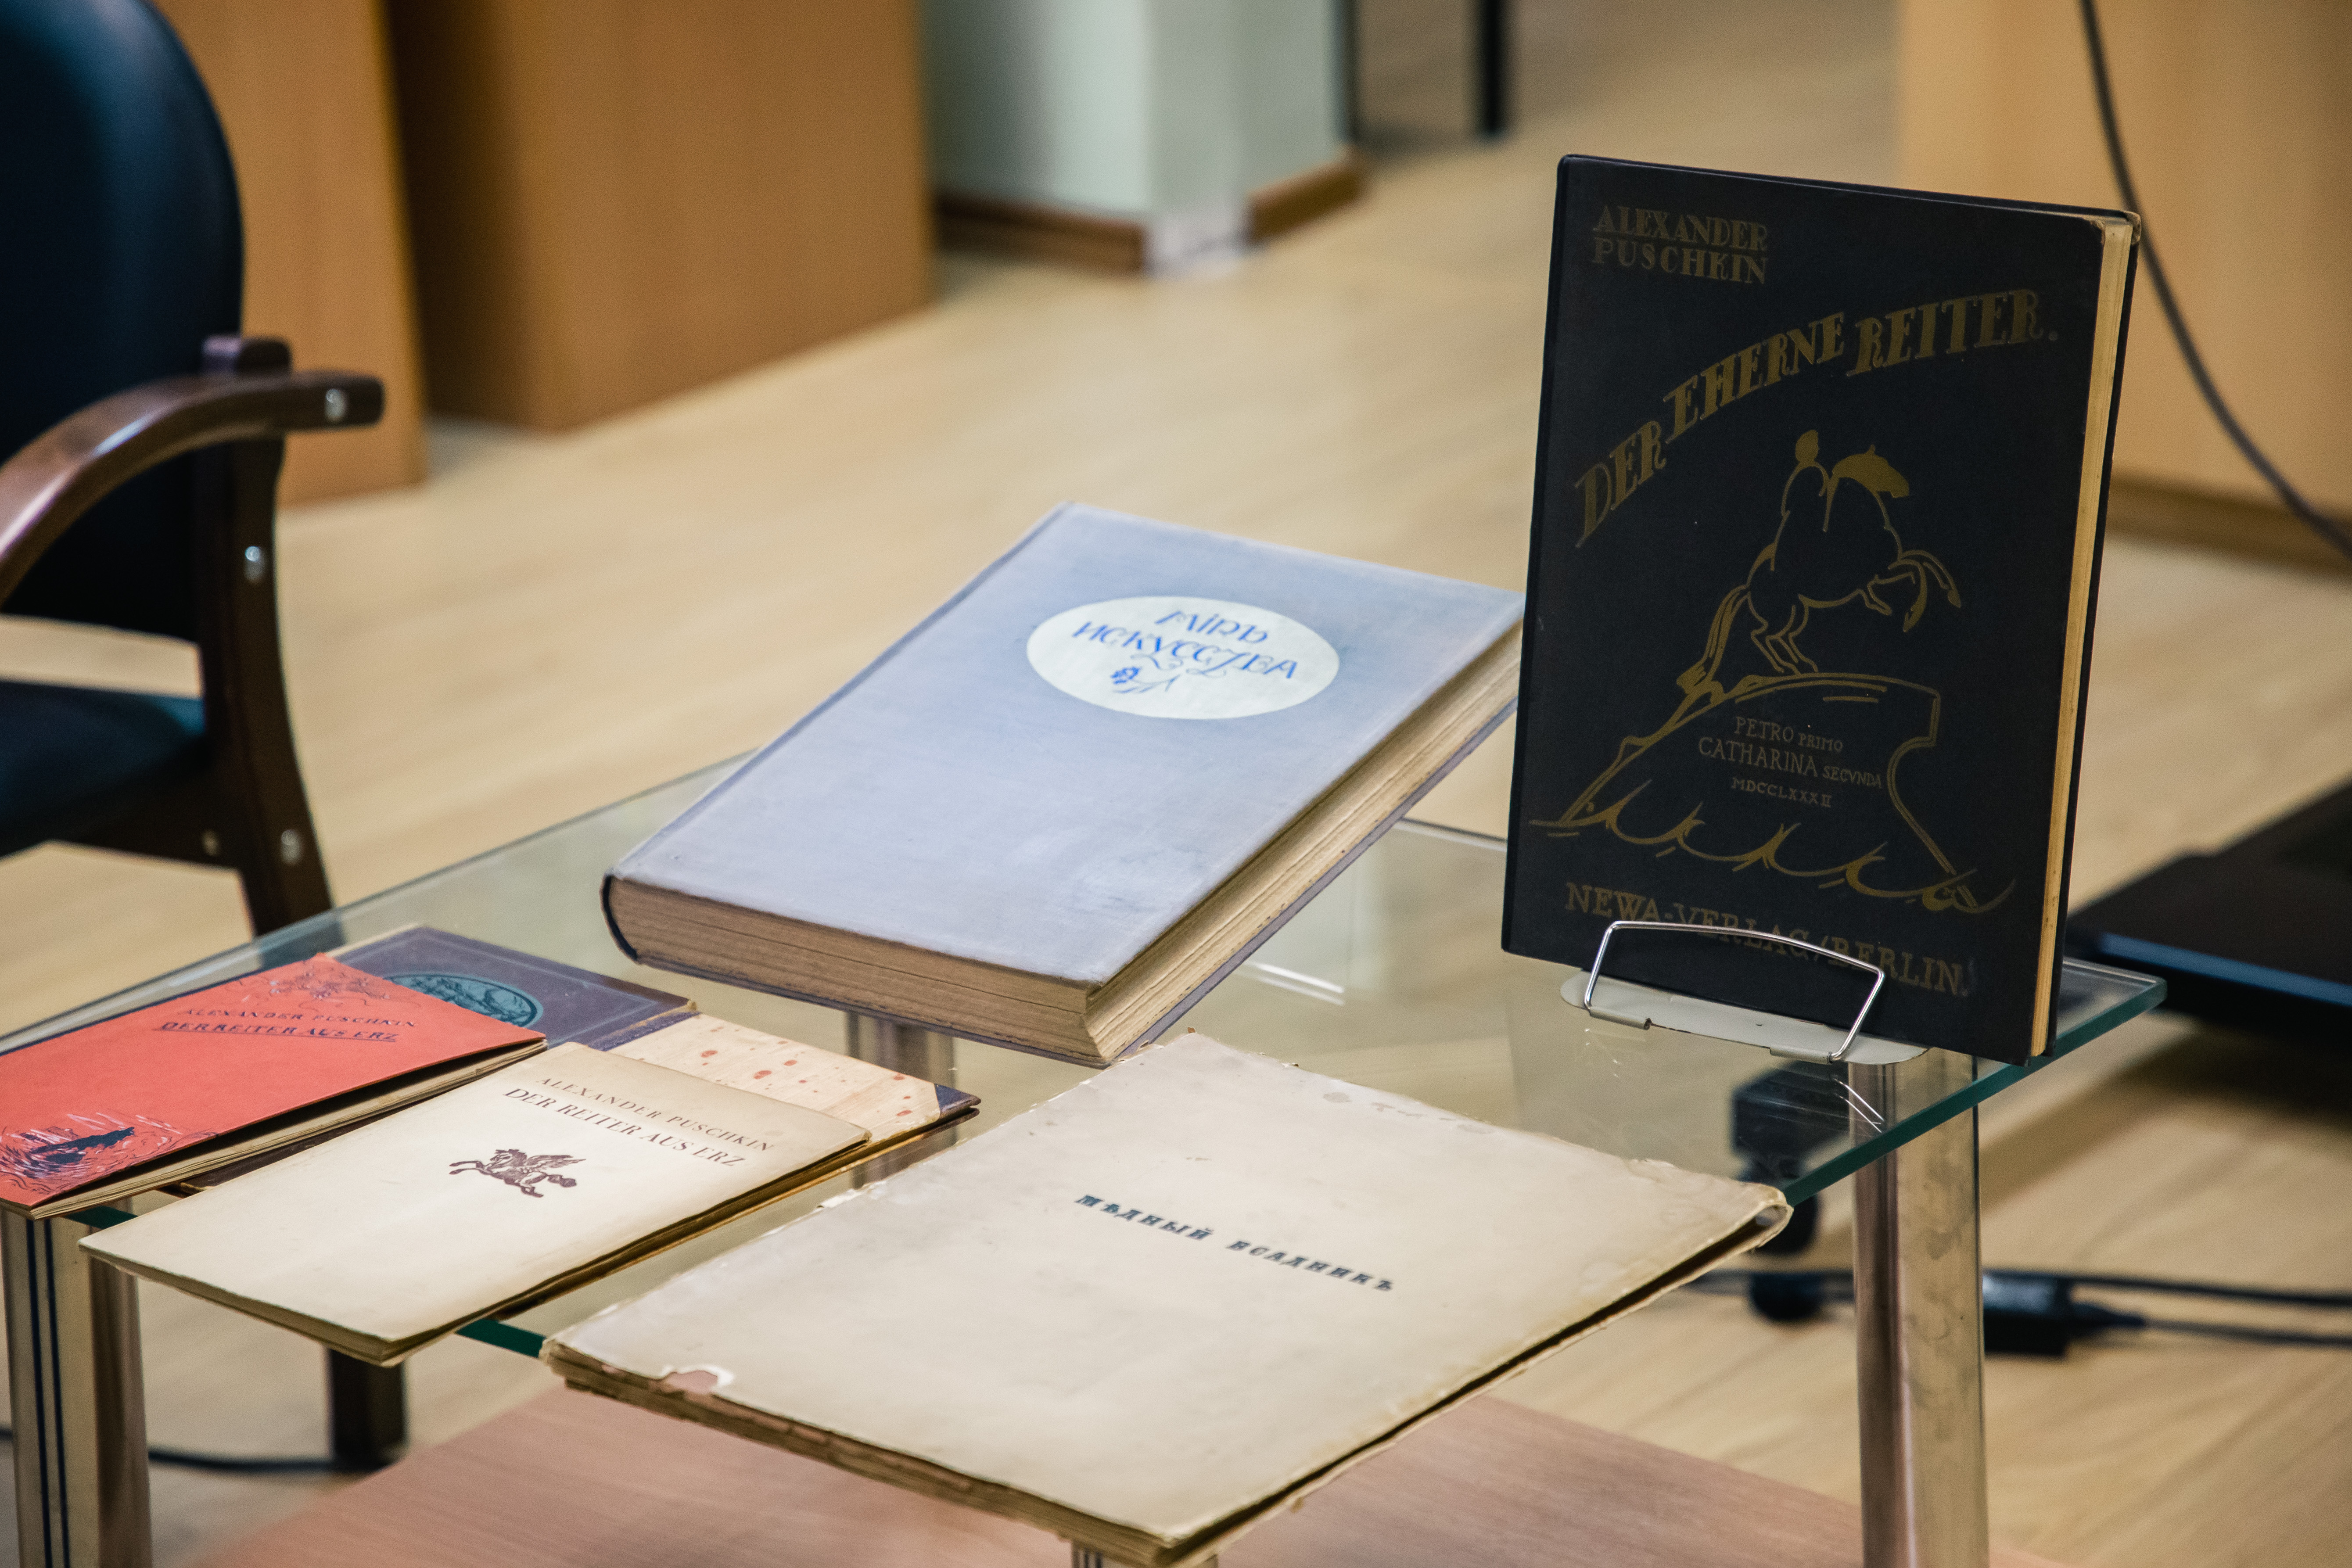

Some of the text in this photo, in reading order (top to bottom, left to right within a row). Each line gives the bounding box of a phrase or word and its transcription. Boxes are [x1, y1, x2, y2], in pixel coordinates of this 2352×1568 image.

[1593, 204, 1768, 251] ALEXANDER
[1592, 237, 1769, 284] PUSCHKIN
[1574, 288, 2058, 548] DER EHERNE REITER.
[1734, 716, 1843, 753] PETRO PRIMO
[1698, 737, 1883, 789] CATHARINA SECVNDA
[161, 1022, 399, 1041] DER REITER AUS ERZ
[179, 1009, 416, 1027] ALEXANDER PUSCHKIN
[503, 1087, 747, 1167] DER REITER AUS ERZ
[535, 1077, 776, 1152] ALEXANDER PUSCHKIN
[1225, 1240, 1393, 1292] ВСАДНИКЪ
